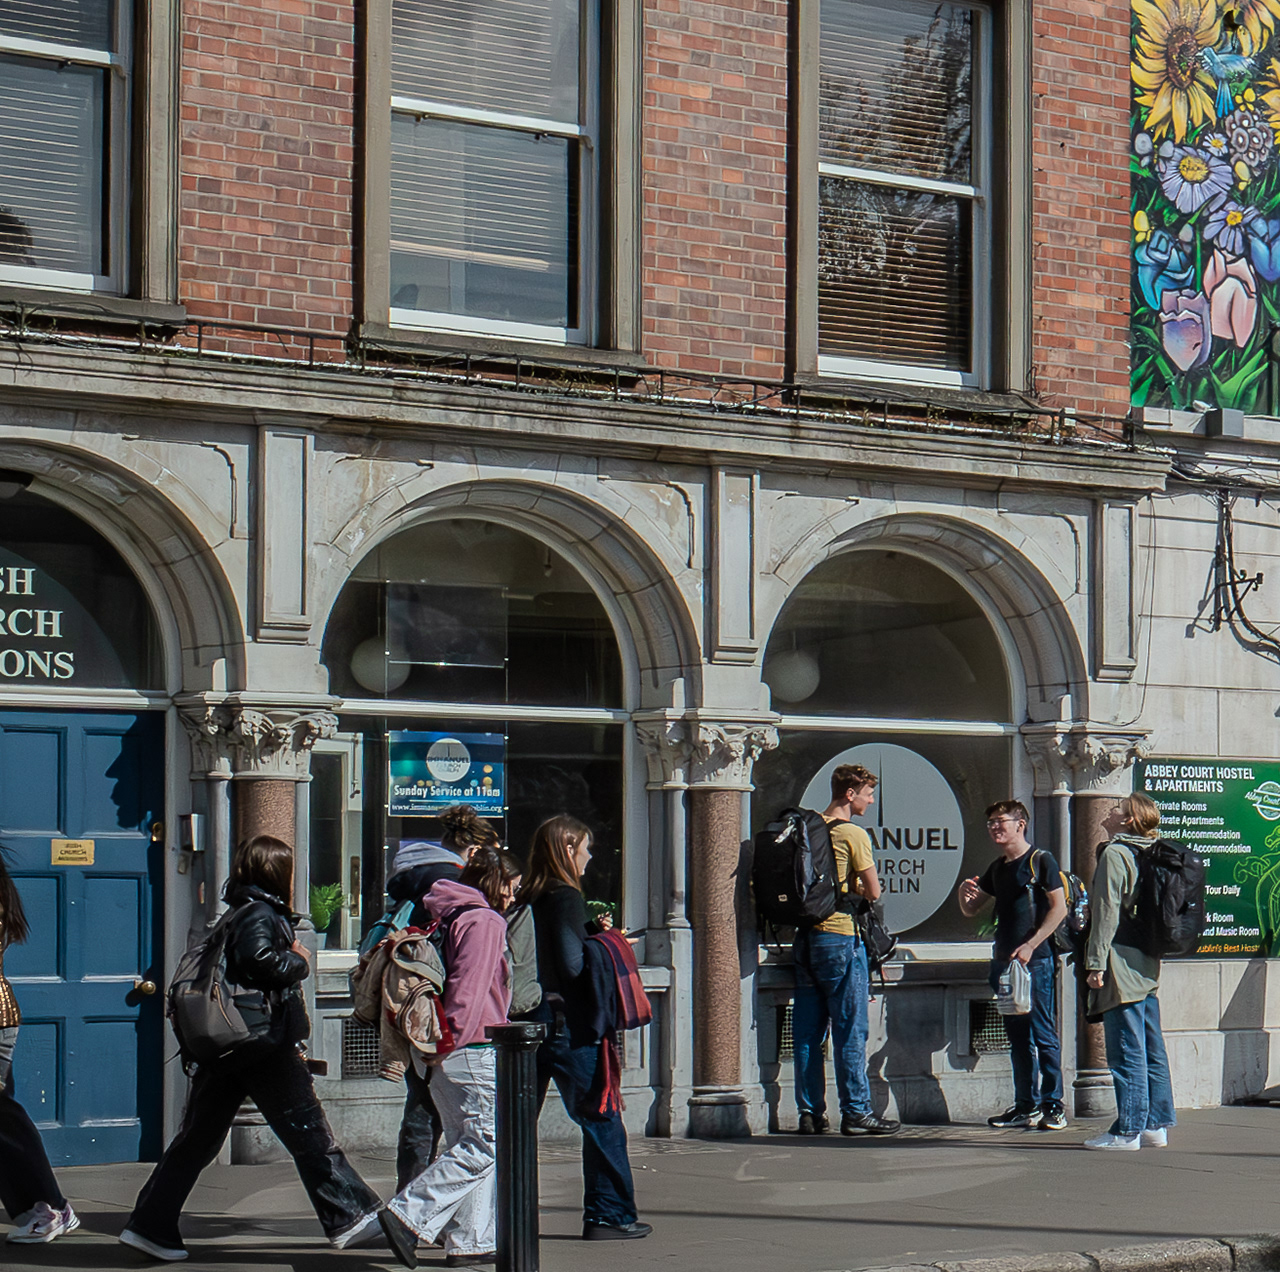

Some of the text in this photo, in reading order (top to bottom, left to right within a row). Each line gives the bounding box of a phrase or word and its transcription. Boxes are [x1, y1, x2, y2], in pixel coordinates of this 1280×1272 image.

[1144, 764, 1255, 780] ABBEY COURT HOSTEL
[394, 785, 501, 798] Sunday Service at 11am
[1144, 780, 1224, 793] & APARTMENTS
[1181, 801, 1207, 811] Rooms
[1159, 815, 1225, 826] rivate Apartments
[865, 827, 958, 851] ANUEL
[1181, 829, 1241, 840] Accommodation
[1193, 843, 1252, 853] Accommodation
[880, 878, 920, 894] BLIN
[1205, 885, 1241, 896] Tour Daily
[1212, 912, 1234, 922] Room
[1215, 927, 1260, 937] Music Room
[1196, 944, 1222, 953] ublin's
[1224, 944, 1240, 953] Best
